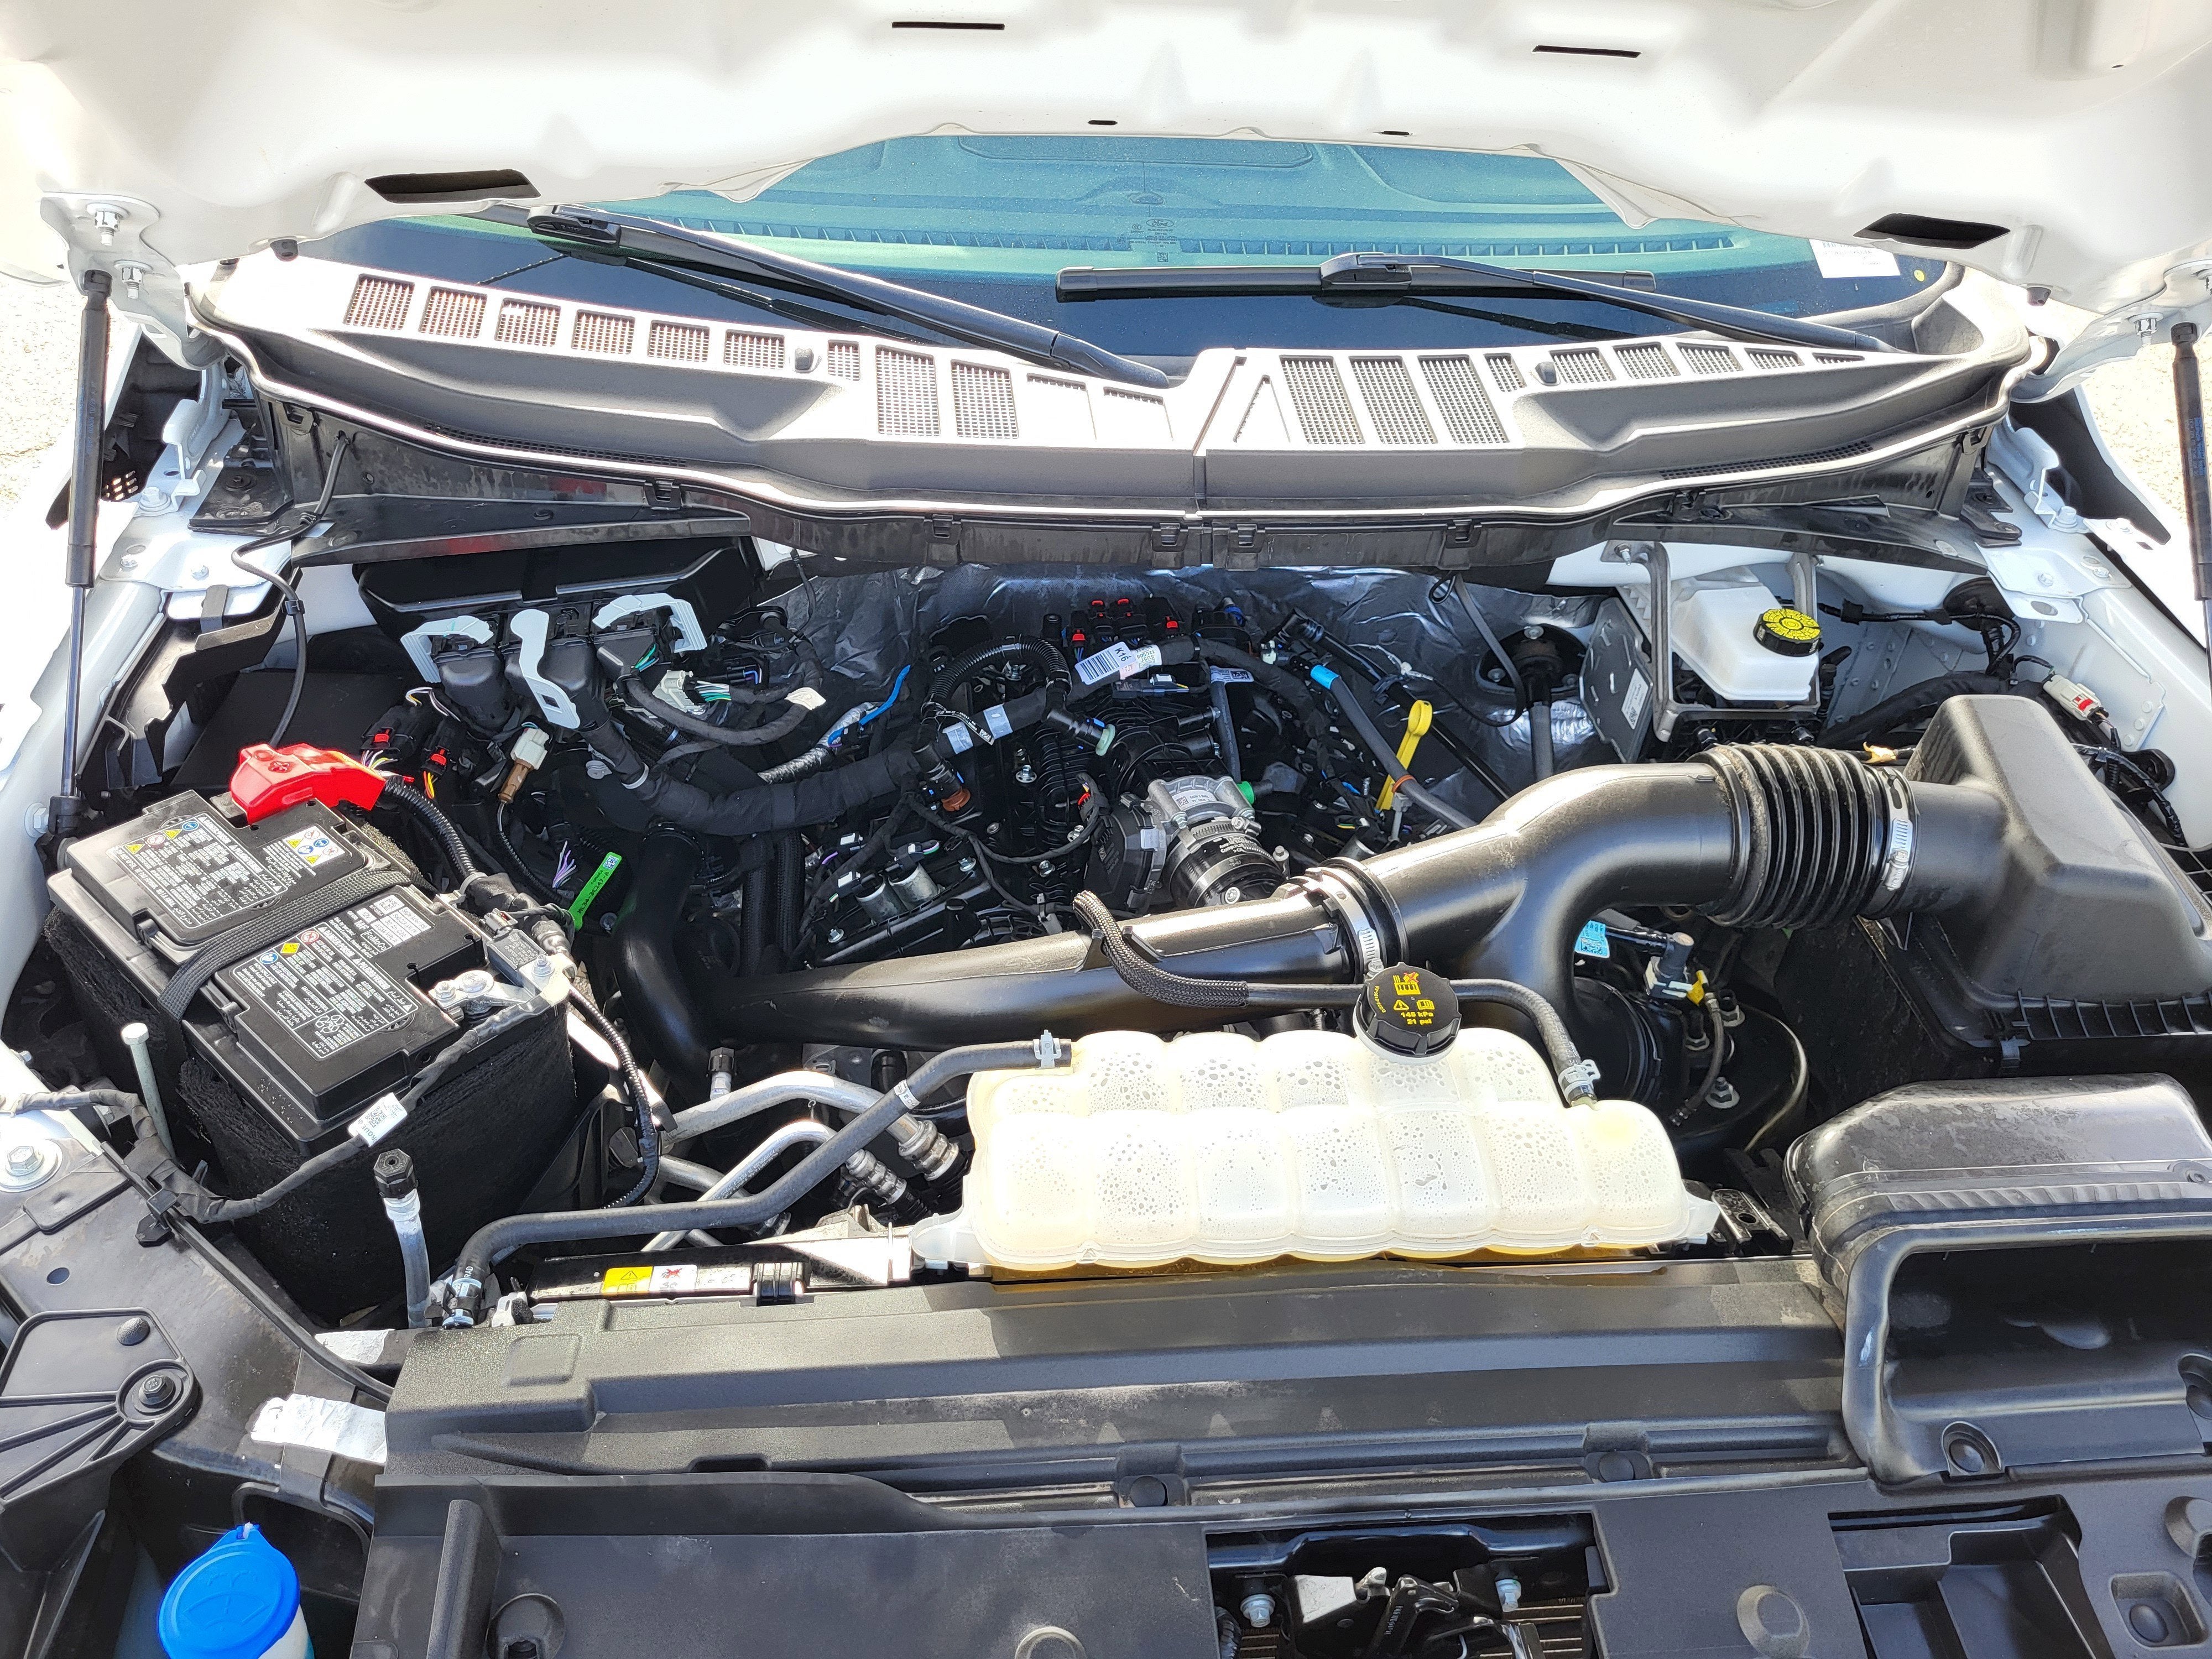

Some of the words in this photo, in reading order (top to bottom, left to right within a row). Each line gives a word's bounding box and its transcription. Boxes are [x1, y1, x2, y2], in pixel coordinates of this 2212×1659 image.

[353, 919, 369, 931] MF
[363, 930, 388, 951] FoMoCo
[241, 968, 255, 979] Batterie
[253, 962, 278, 984] NON-SPILLABLE
[259, 977, 274, 988] Battery
[281, 989, 297, 1003] CONTRA
[463, 1266, 473, 1278] RAD
